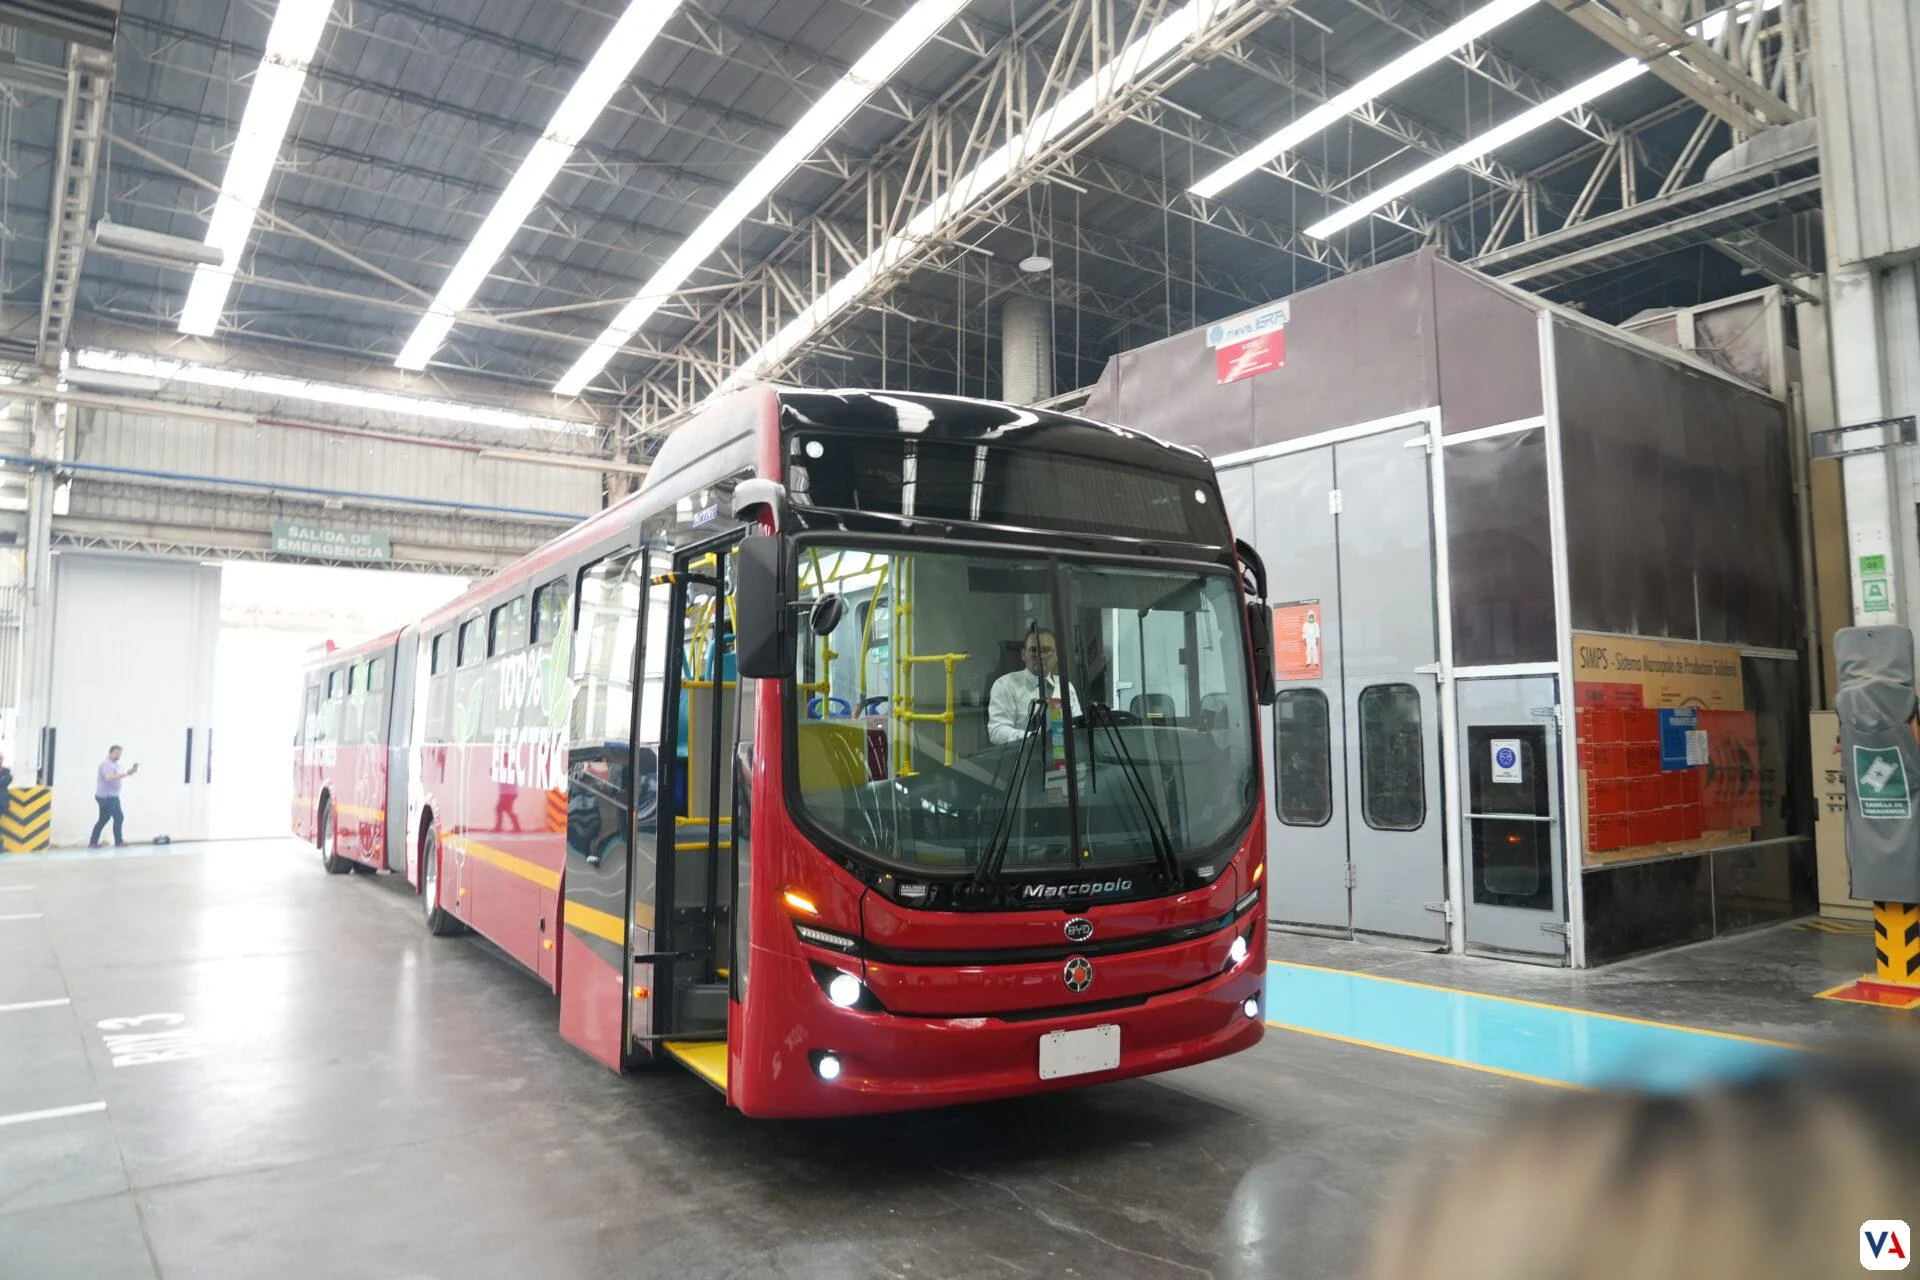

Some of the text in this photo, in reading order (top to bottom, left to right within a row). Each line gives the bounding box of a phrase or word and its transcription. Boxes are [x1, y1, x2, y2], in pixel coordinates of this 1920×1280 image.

[287, 526, 373, 546] SALIDA DE
[277, 538, 384, 558] EMERGENCIA
[1580, 646, 1608, 670] SIMPS
[499, 646, 544, 711] 100%
[1022, 878, 1133, 898] Marcopolo
[1067, 924, 1091, 936] BYD
[96, 1012, 187, 1031] 3
